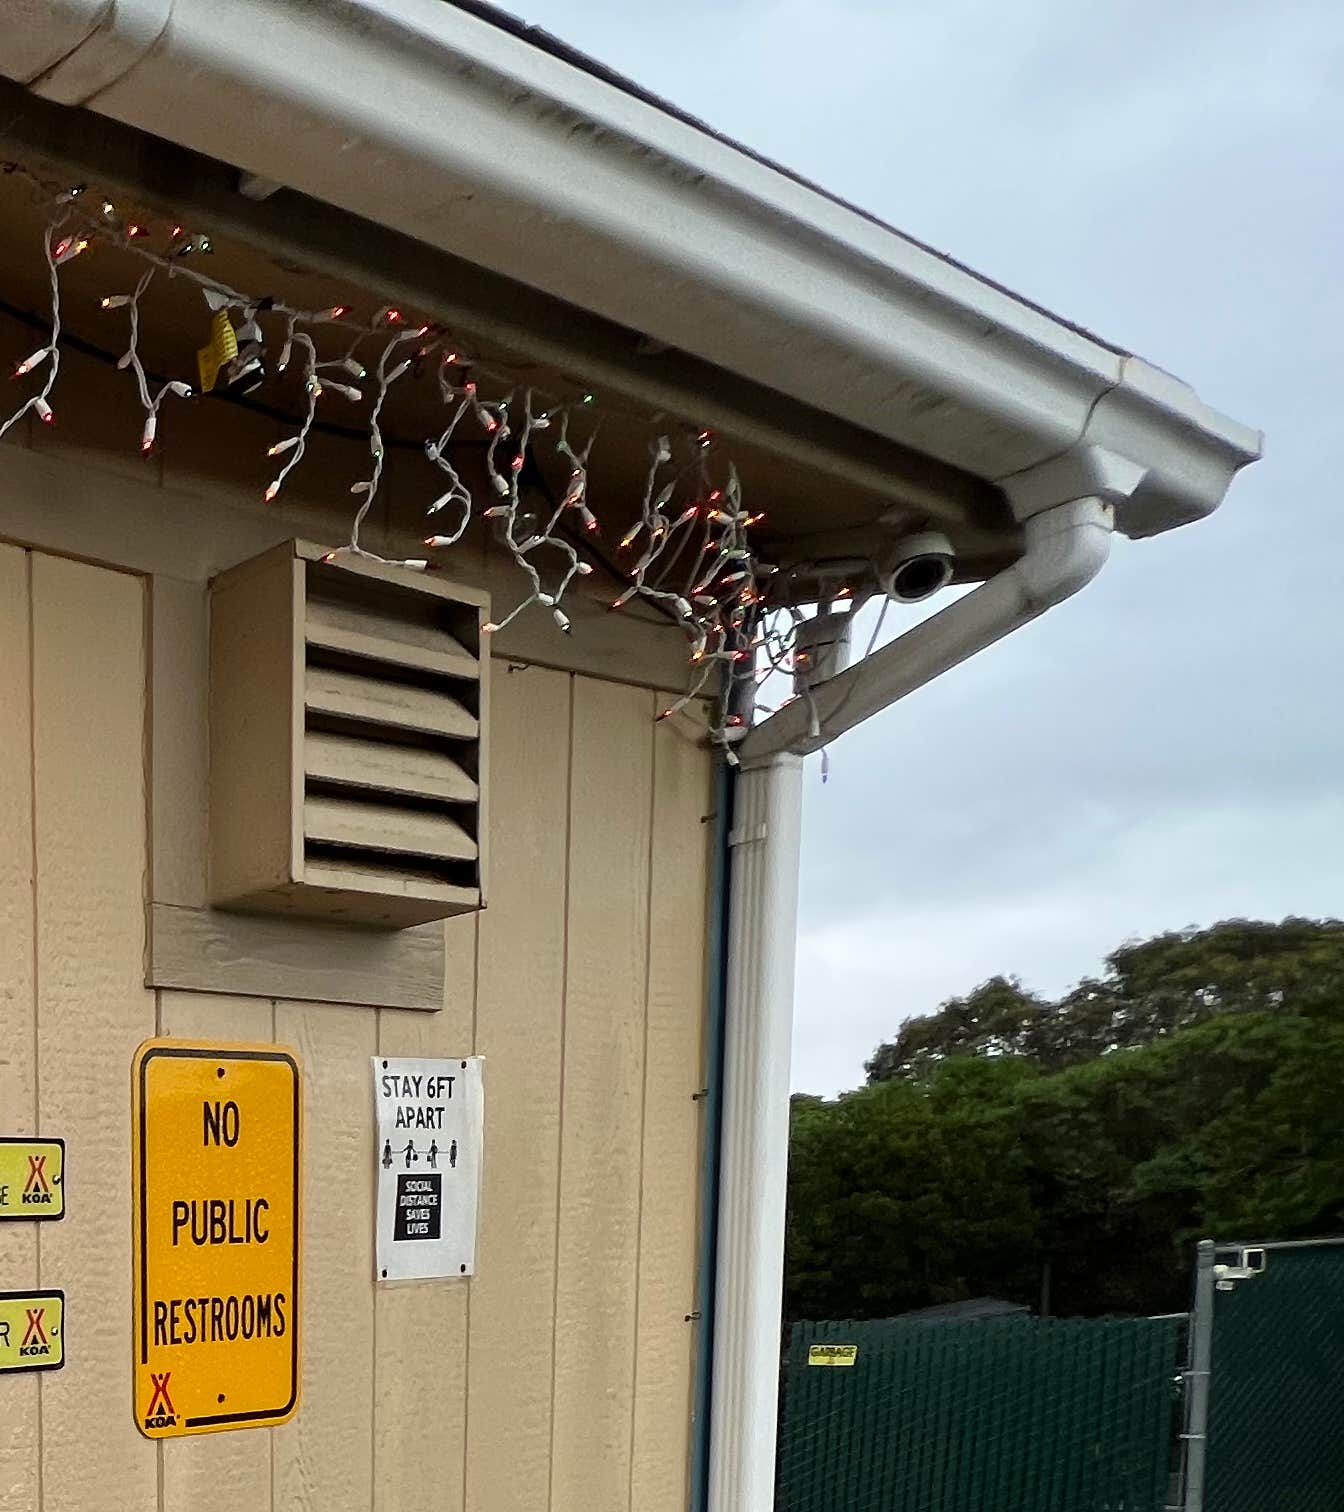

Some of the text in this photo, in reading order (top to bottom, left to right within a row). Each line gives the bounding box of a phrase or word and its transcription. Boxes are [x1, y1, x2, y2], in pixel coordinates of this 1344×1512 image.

[382, 1075, 455, 1099] STAY 6FT
[202, 1101, 240, 1147] NO
[395, 1107, 445, 1129] APART
[405, 1181, 433, 1192] SOCIAL
[22, 1192, 52, 1205] KOA
[400, 1194, 438, 1206] DISTANCE
[406, 1209, 430, 1220] SAVES
[172, 1200, 270, 1247] PUBLIC
[407, 1223, 428, 1234] LIVES
[154, 1293, 286, 1346] RESTROOMS
[19, 1344, 51, 1357] KOA
[144, 1413, 181, 1429] KOA
